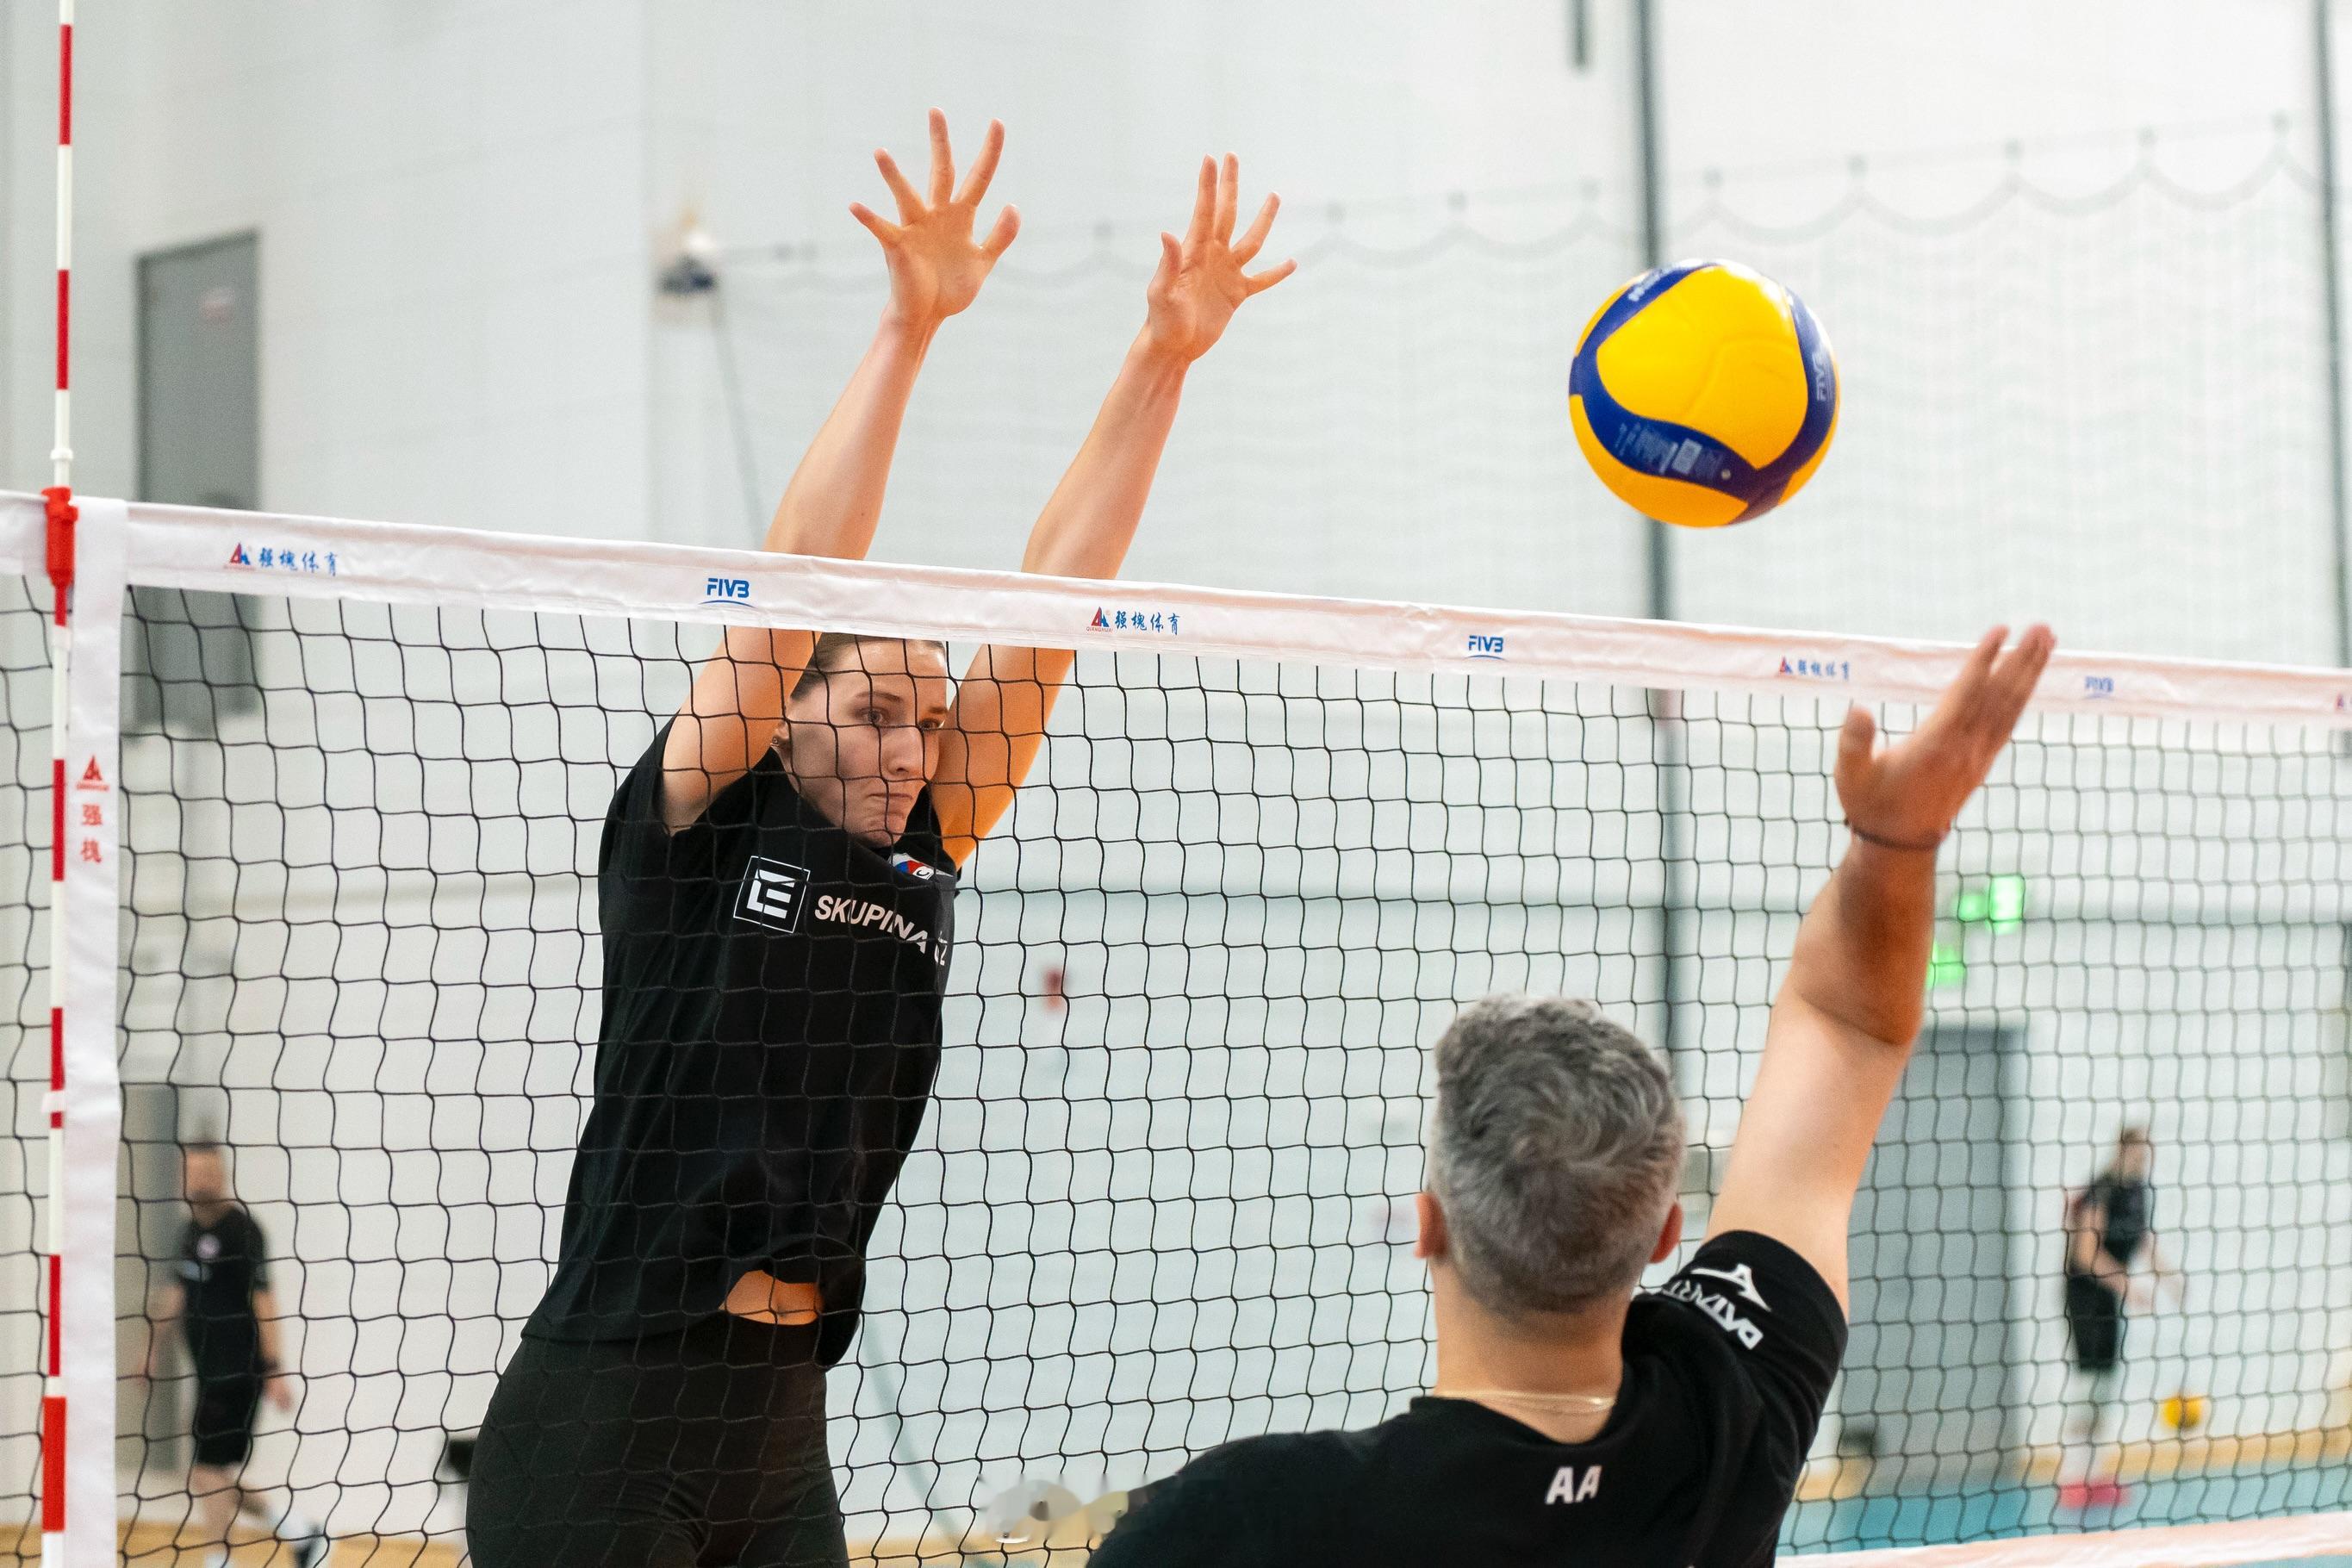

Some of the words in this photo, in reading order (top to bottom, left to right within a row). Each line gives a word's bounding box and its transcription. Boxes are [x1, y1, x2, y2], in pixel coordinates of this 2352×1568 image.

[706, 577, 750, 598] FIVB
[1468, 635, 1504, 653] FIVB
[814, 894, 929, 954] SKUPINA
[1546, 1465, 1602, 1504] AA
